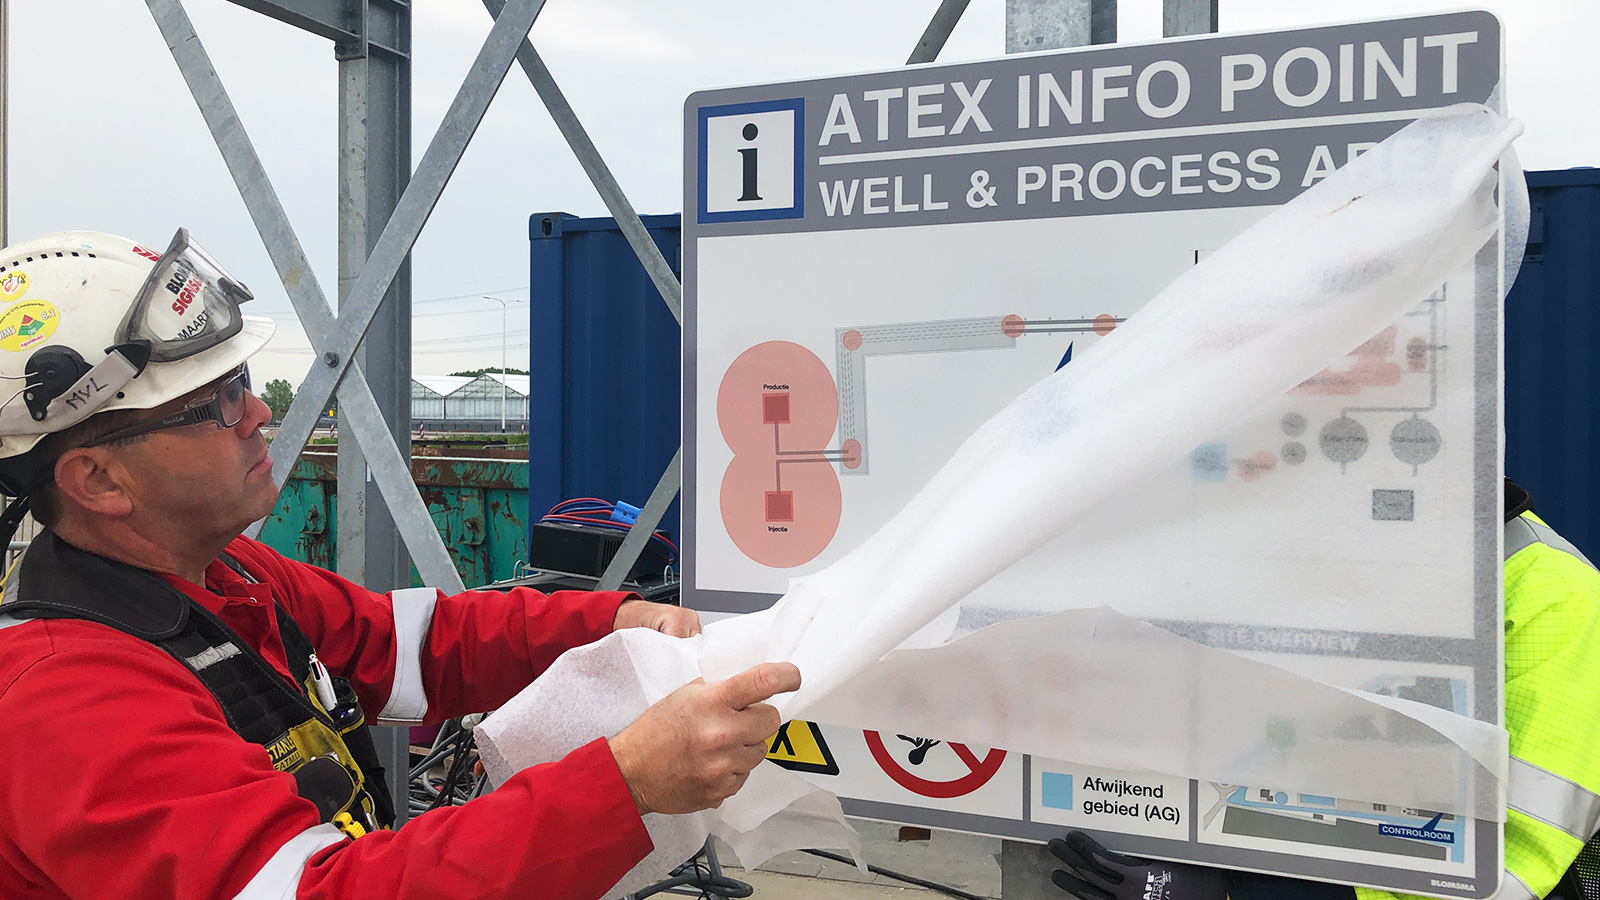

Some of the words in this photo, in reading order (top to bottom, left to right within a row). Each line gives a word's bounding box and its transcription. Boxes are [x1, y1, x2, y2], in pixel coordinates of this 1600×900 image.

[818, 78, 994, 146] ATEX
[1017, 59, 1192, 129] INFO
[1220, 31, 1479, 112] POINT
[818, 173, 949, 217] WELL
[965, 169, 998, 209] &
[1017, 147, 1281, 205] PROCESS
[762, 383, 790, 391] Productie
[767, 525, 789, 533] Injectie
[1083, 776, 1164, 799] Afwijkend
[1083, 799, 1139, 817] gebied
[1144, 804, 1181, 825] (AG)
[1381, 825, 1451, 841] CONTROLROOM
[1430, 879, 1477, 892] BLOMSMA
